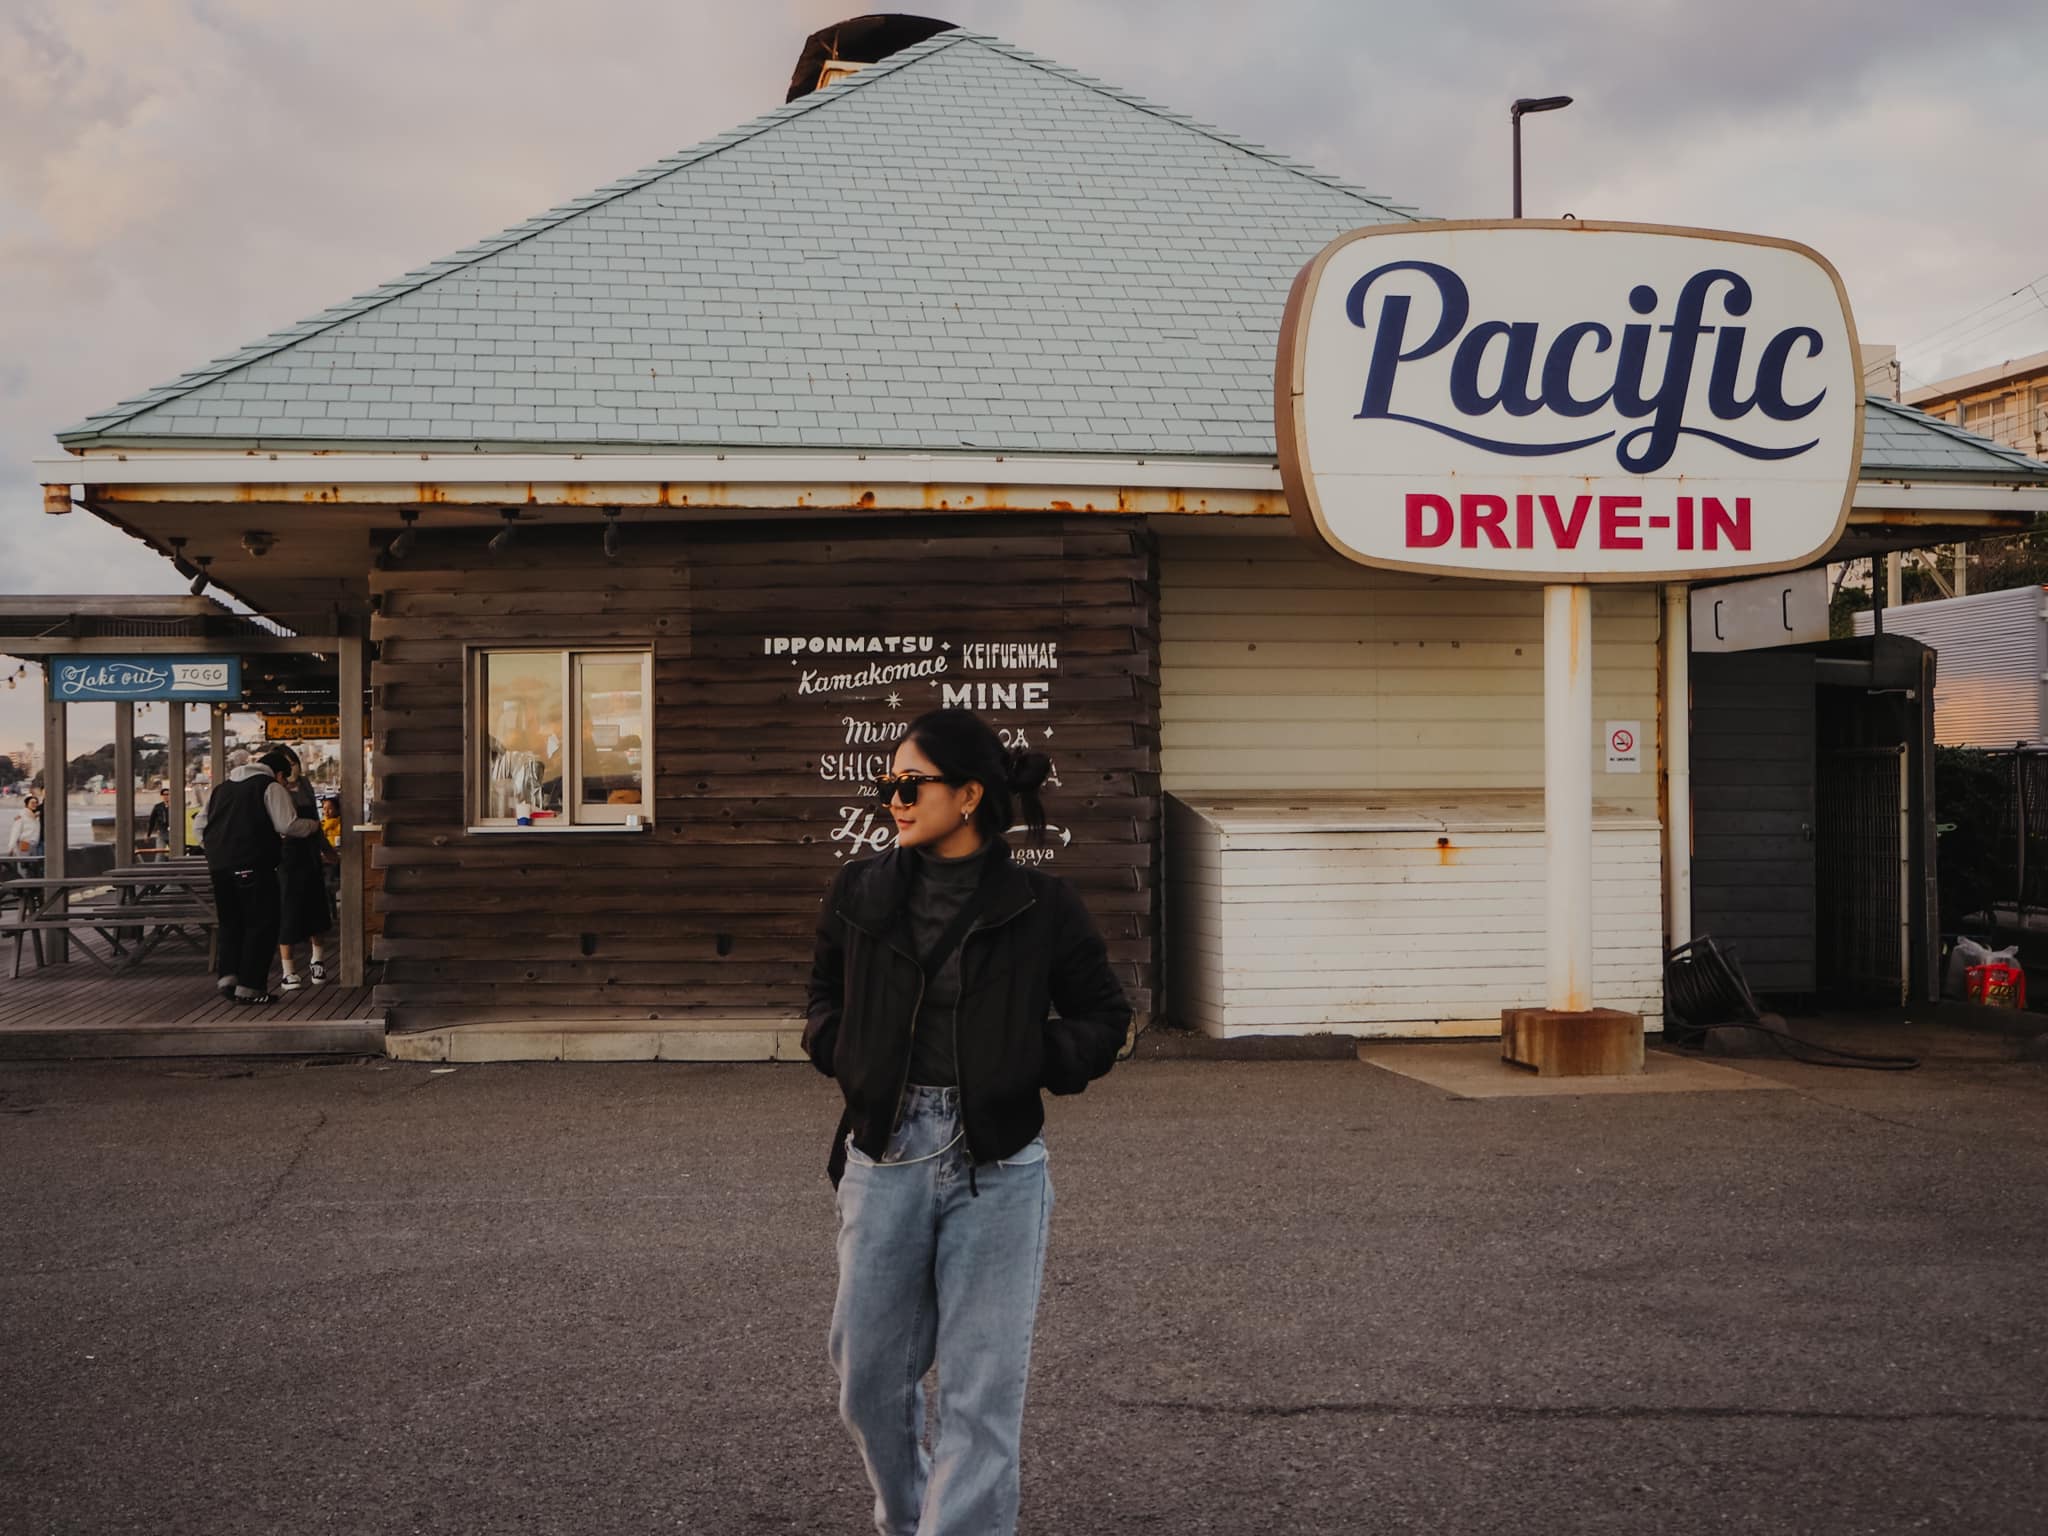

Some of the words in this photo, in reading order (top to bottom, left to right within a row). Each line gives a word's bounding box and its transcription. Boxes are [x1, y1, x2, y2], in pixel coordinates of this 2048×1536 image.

[1346, 260, 1827, 474] Pacific
[1405, 493, 1751, 551] DRIVE-IN
[764, 636, 934, 655] IPPONMATSU
[61, 664, 116, 694] Take
[116, 664, 168, 686] out
[798, 655, 948, 695] Kamakomae
[942, 682, 1049, 710] MINE
